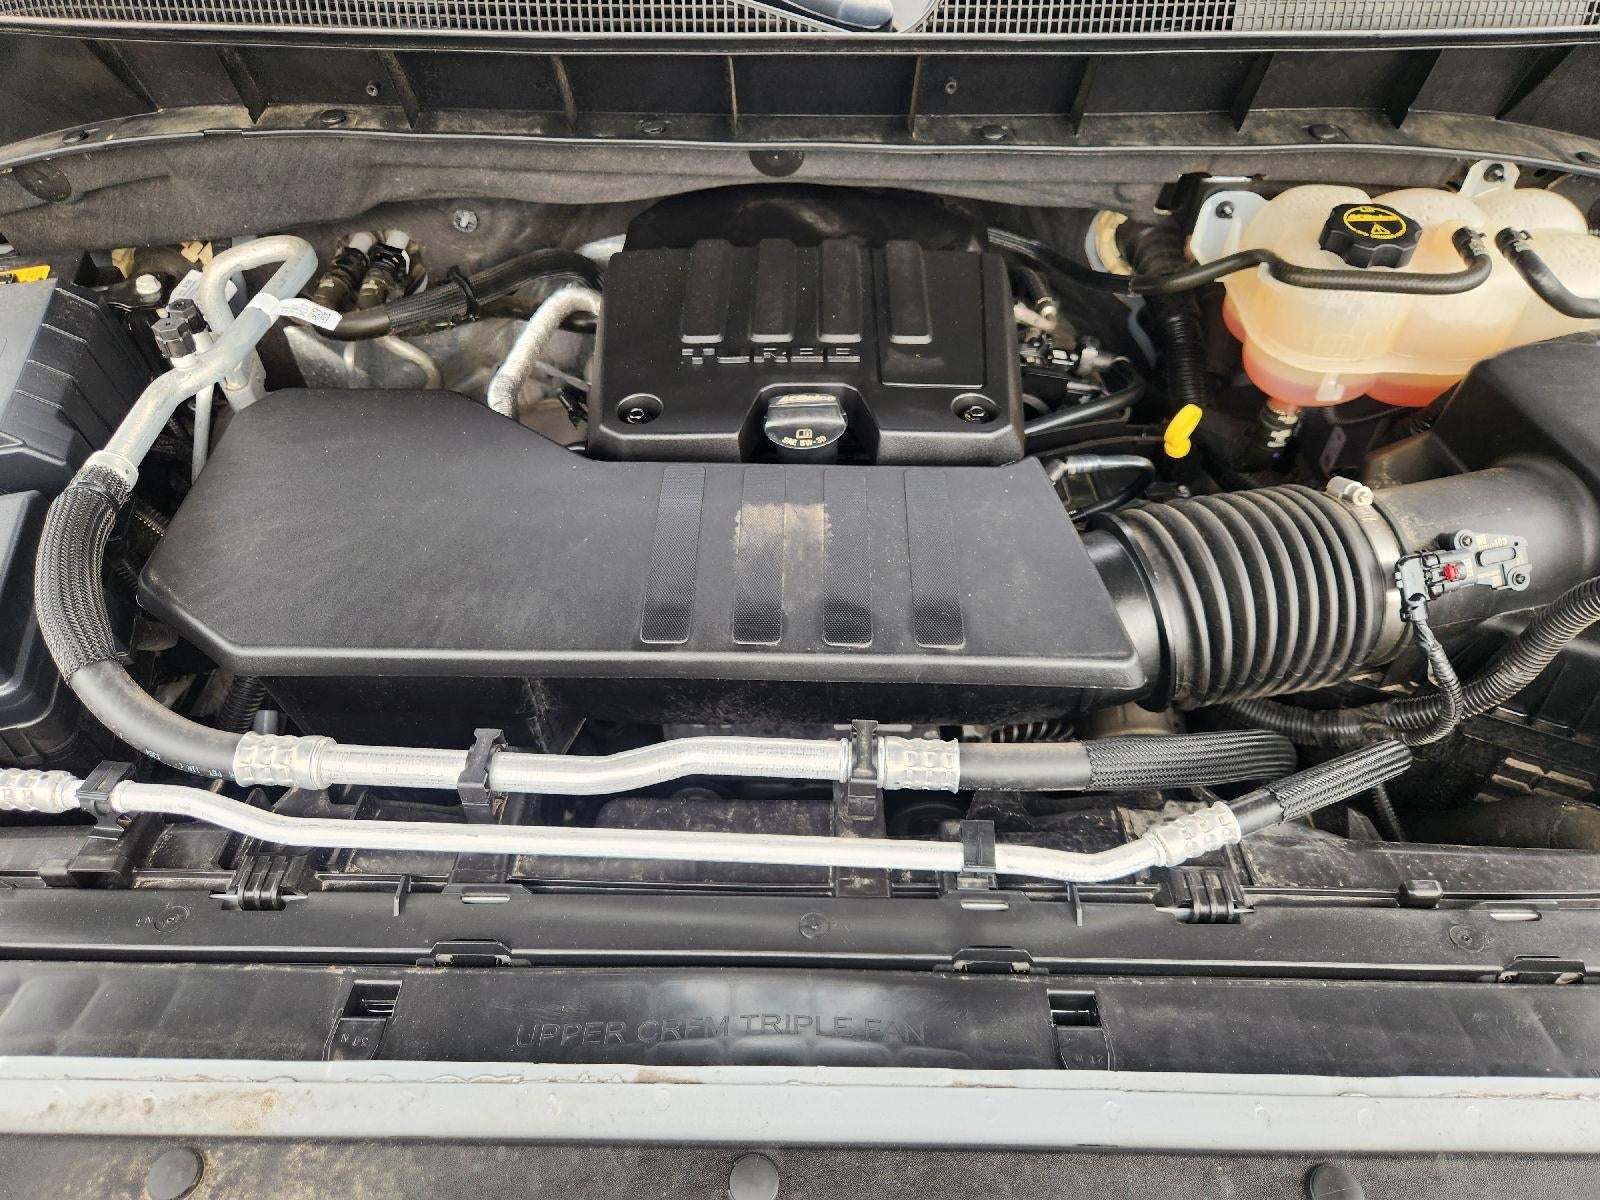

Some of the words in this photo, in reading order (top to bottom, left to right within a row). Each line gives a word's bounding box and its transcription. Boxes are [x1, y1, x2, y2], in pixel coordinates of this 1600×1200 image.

[515, 1020, 627, 1048] UPPER
[637, 1015, 730, 1043] CRFM
[739, 1013, 854, 1038] TRIPLE
[864, 1017, 928, 1042] FAN
